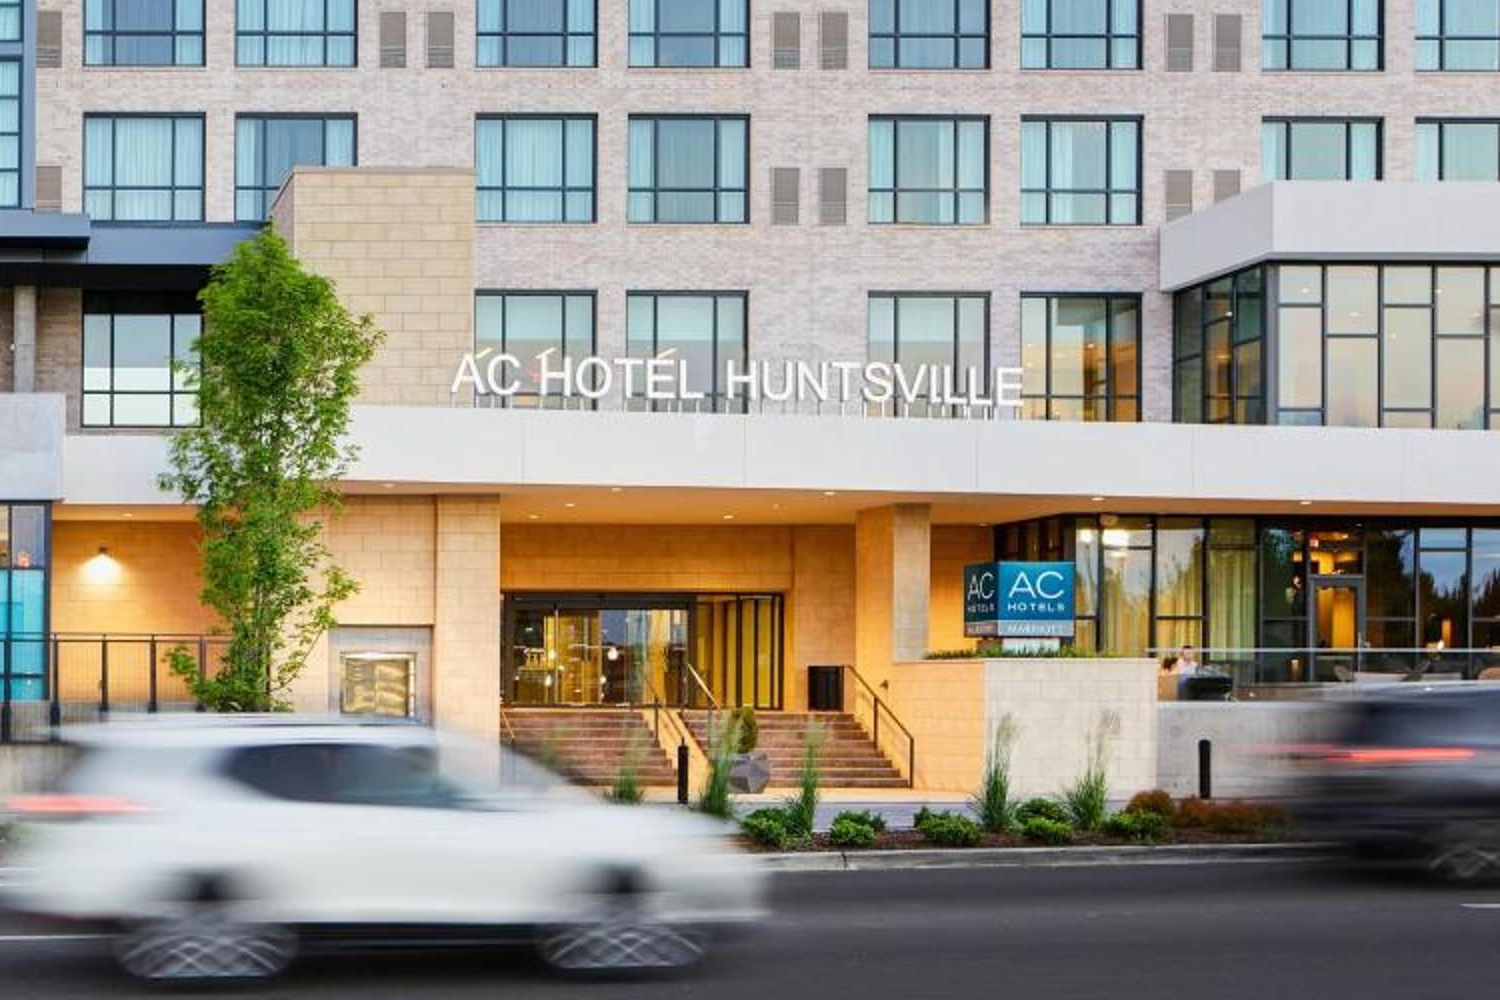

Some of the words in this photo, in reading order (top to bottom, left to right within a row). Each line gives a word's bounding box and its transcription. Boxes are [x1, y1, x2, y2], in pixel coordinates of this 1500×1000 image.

[451, 353, 521, 395] AC
[539, 356, 705, 399] HOTEL
[726, 359, 1024, 407] HUNTSVILLE
[967, 571, 995, 600] AC
[1008, 571, 1064, 599] AC
[1007, 602, 1065, 612] HOTELS
